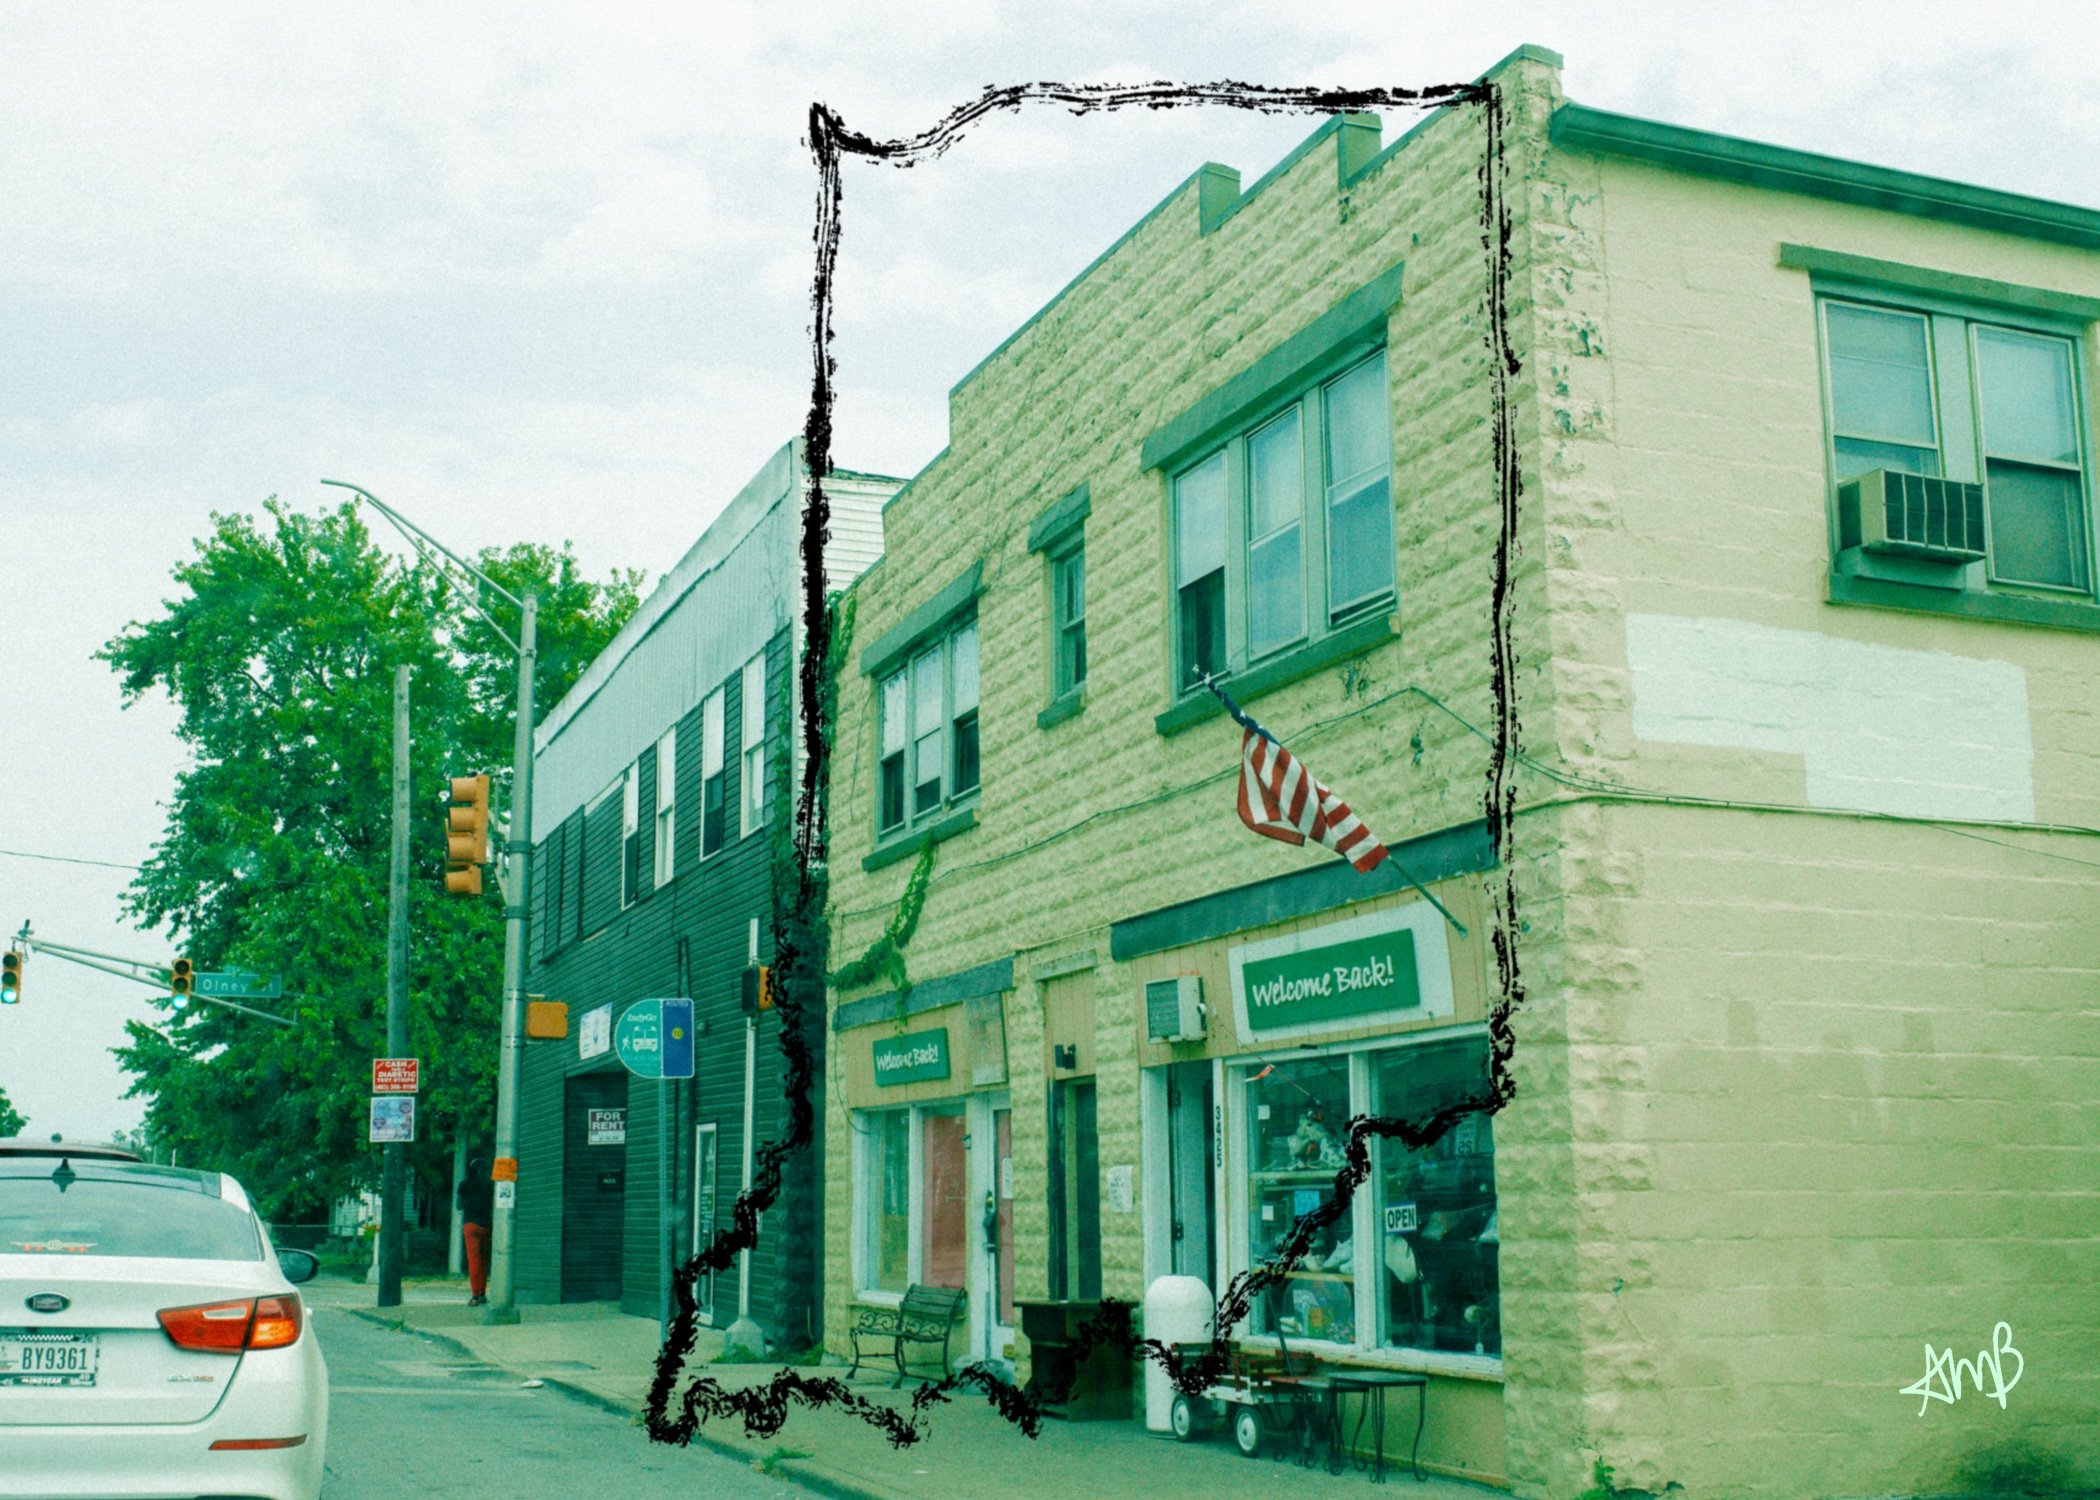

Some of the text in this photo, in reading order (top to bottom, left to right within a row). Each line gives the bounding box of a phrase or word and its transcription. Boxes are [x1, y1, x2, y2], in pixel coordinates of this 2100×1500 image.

[203, 979, 248, 993] Olney
[1252, 955, 1394, 1007] Welcome Back!
[627, 1013, 657, 1023] IndyGo
[876, 1043, 939, 1072] Welcome Back!
[592, 1121, 625, 1130] RENT
[596, 1112, 621, 1121] FOR
[1387, 1208, 1415, 1230] OPEN
[22, 1347, 87, 1370] BY9361
